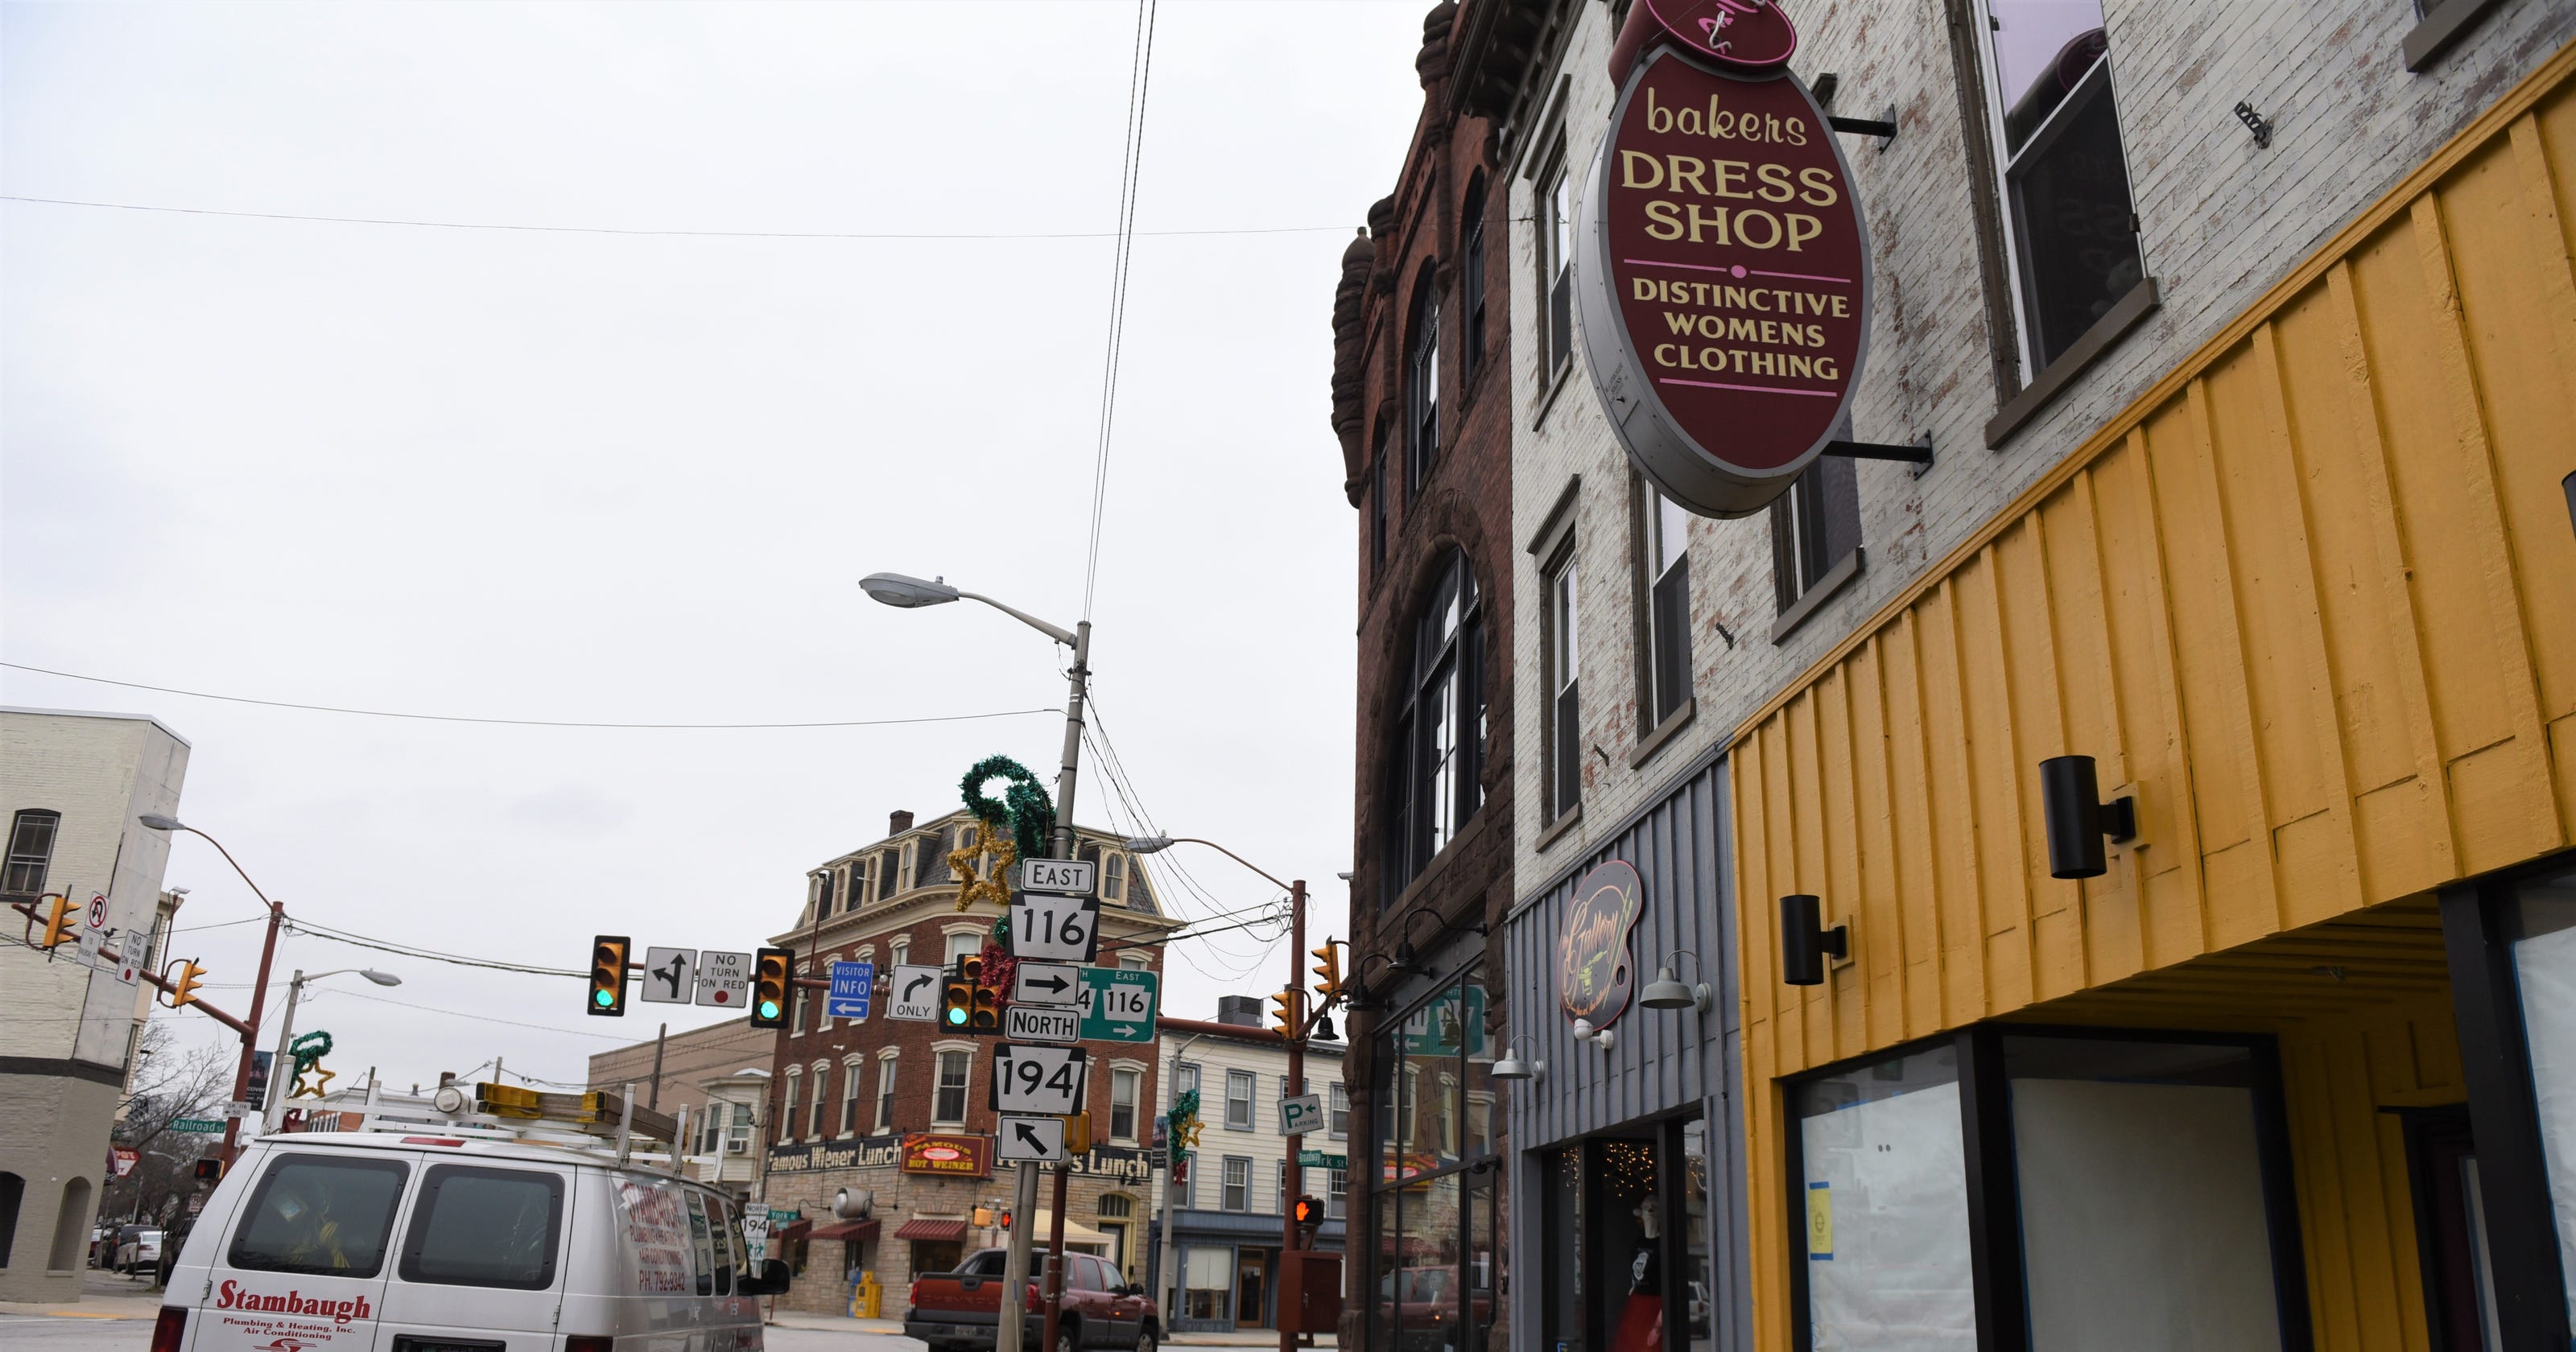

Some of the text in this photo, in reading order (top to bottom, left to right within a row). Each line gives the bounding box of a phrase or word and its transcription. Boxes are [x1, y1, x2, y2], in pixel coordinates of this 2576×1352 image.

[1646, 86, 1808, 147] bakers
[1620, 149, 1838, 208] DRESS
[1643, 200, 1823, 252] SHOP
[1632, 277, 1851, 319] DISTINCTIVE
[1662, 311, 1826, 348] WOMENS
[1653, 343, 1839, 381] CLOTHING
[1033, 864, 1083, 886] EAST
[1024, 909, 1085, 946] 116
[131, 934, 142, 946] NO
[128, 946, 141, 958] TURN
[122, 955, 141, 969] ON RED
[716, 954, 737, 966] NO
[711, 967, 740, 978] TURN
[836, 966, 869, 977] VISITOR
[1116, 971, 1140, 981] EAST
[701, 979, 745, 990] ON RED
[835, 979, 868, 995] INFO
[1108, 991, 1145, 1013] 116
[897, 1004, 931, 1017] ONLY
[1013, 1012, 1075, 1037] NORTH
[1003, 1058, 1073, 1098] 194
[173, 1119, 216, 1131] Railroad
[768, 1150, 808, 1172] Famous
[811, 1146, 857, 1169] Wiener
[857, 1139, 902, 1167] Lunch
[913, 1141, 972, 1156] FAMOUS
[908, 1159, 973, 1170] HOT WEINER
[1088, 1148, 1149, 1177] Lunch
[1298, 1152, 1320, 1164] Broadway
[1321, 1155, 1332, 1166] rk
[746, 1203, 768, 1213] NORTH
[772, 1212, 788, 1220] York
[743, 1219, 767, 1233] 194
[639, 1270, 686, 1292] PH. 792-9342
[217, 1279, 370, 1324] Stambaugh
[223, 1317, 273, 1329] Plumbing
[288, 1322, 332, 1333] Heating,
[336, 1325, 356, 1333] Inc.
[243, 1327, 332, 1341] Air Conditioning
